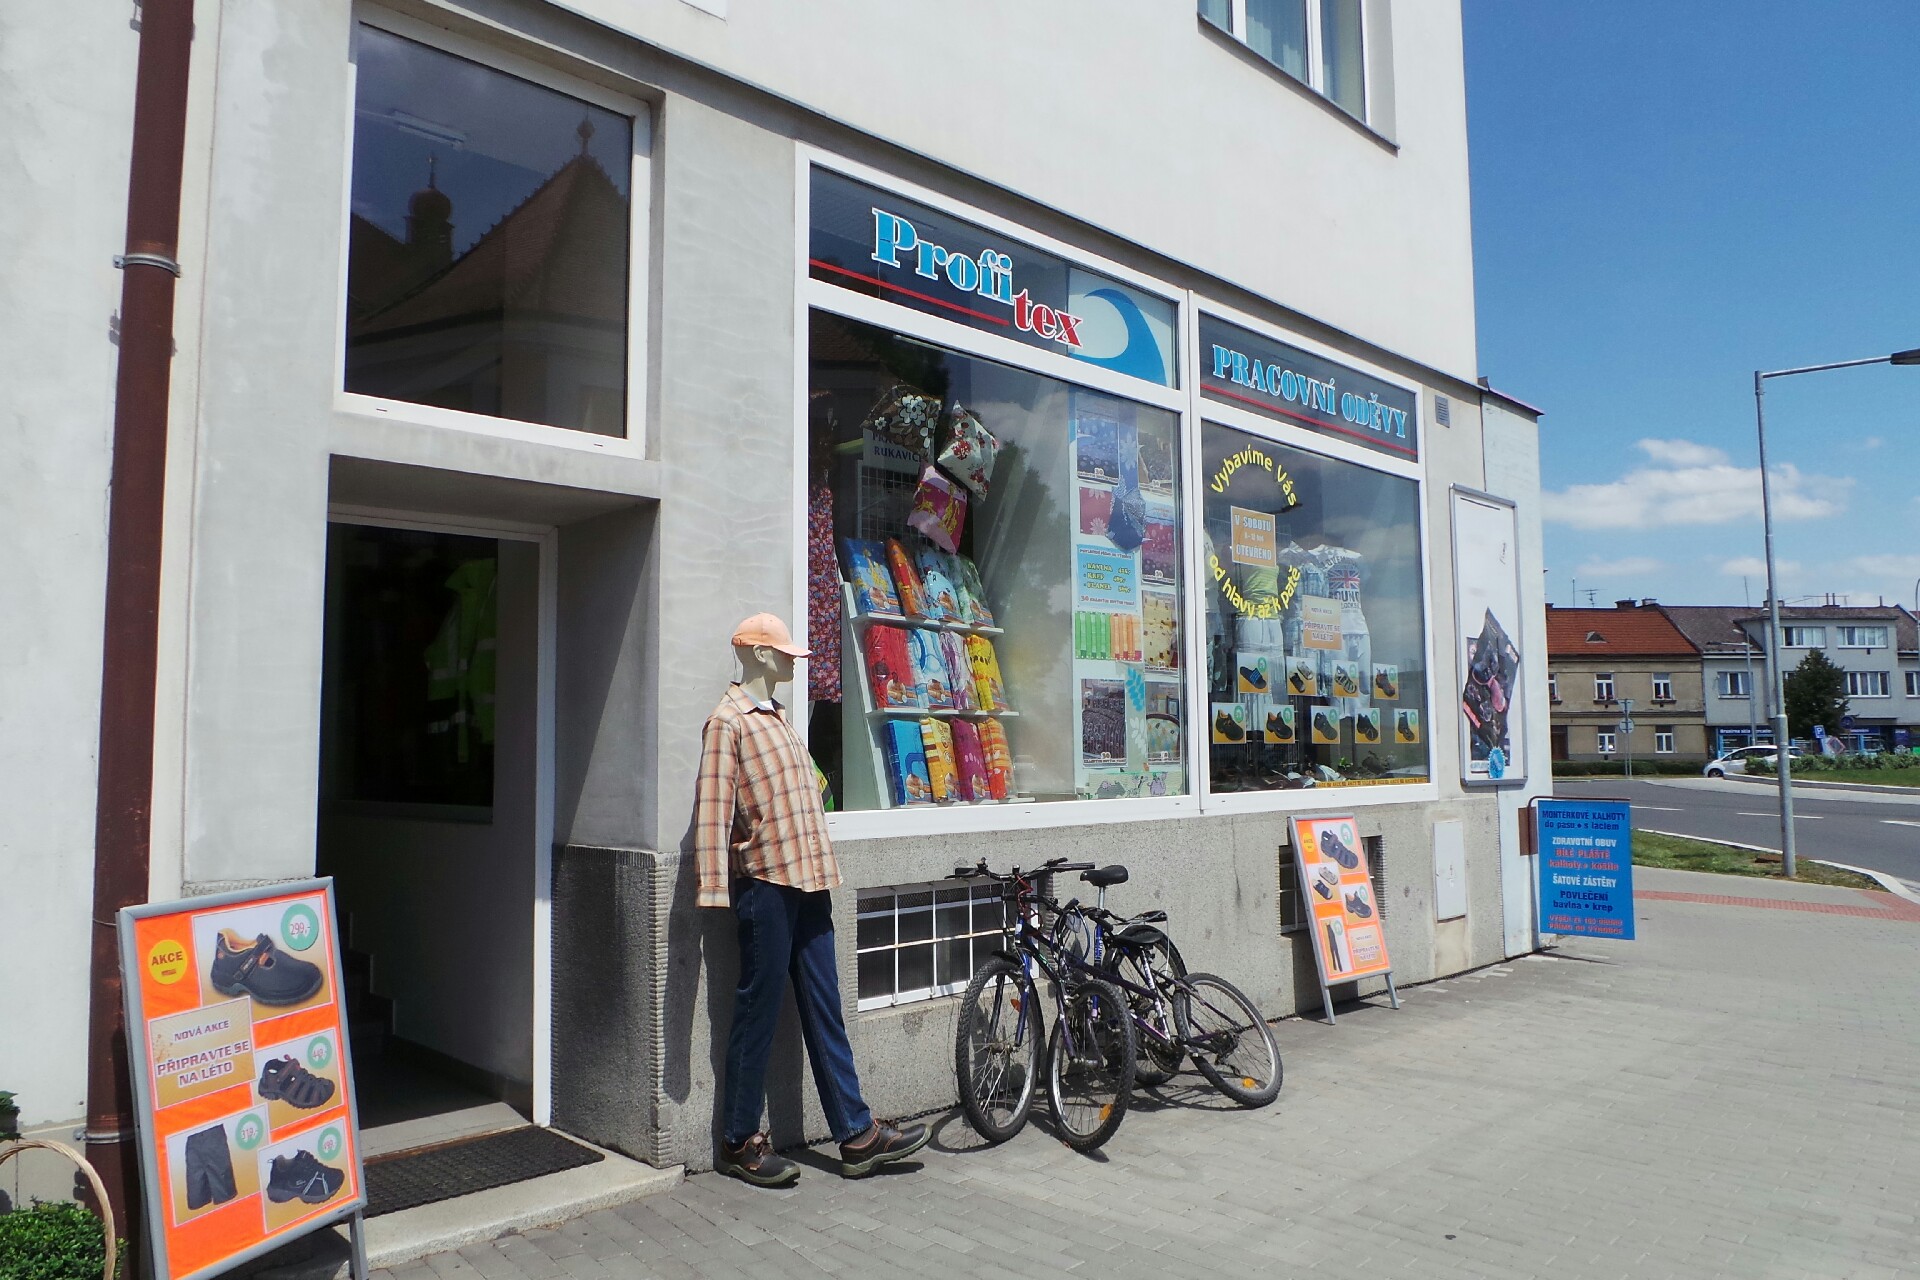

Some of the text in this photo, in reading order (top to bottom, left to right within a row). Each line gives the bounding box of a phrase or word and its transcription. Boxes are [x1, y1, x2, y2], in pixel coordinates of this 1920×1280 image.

[1211, 344, 1408, 440] PRACOVNÍ ODĚVY
[1211, 443, 1297, 506] Vybavíme Vás
[1234, 514, 1272, 532] V SOBOTU
[1236, 543, 1272, 560] OTEVŘENO
[1222, 577, 1255, 621] hlavy
[1258, 597, 1271, 619] až
[1280, 565, 1300, 610] patě
[1592, 811, 1626, 821] KALHOTY
[1552, 836, 1617, 847] ZDRAVOTNÍ OBUV
[1552, 873, 1617, 888] ŠATOVÉ ZÁSTĚRY
[1560, 890, 1608, 902] POVLEČENÍ
[1553, 900, 1613, 913] bavlna krep
[289, 920, 311, 936] 299,-
[151, 951, 183, 966] AKCE
[174, 1020, 230, 1042] NOVÁ AKCE
[157, 1040, 250, 1076] PŘIPRAVTE SE
[179, 1061, 233, 1086] NA LÉTO
